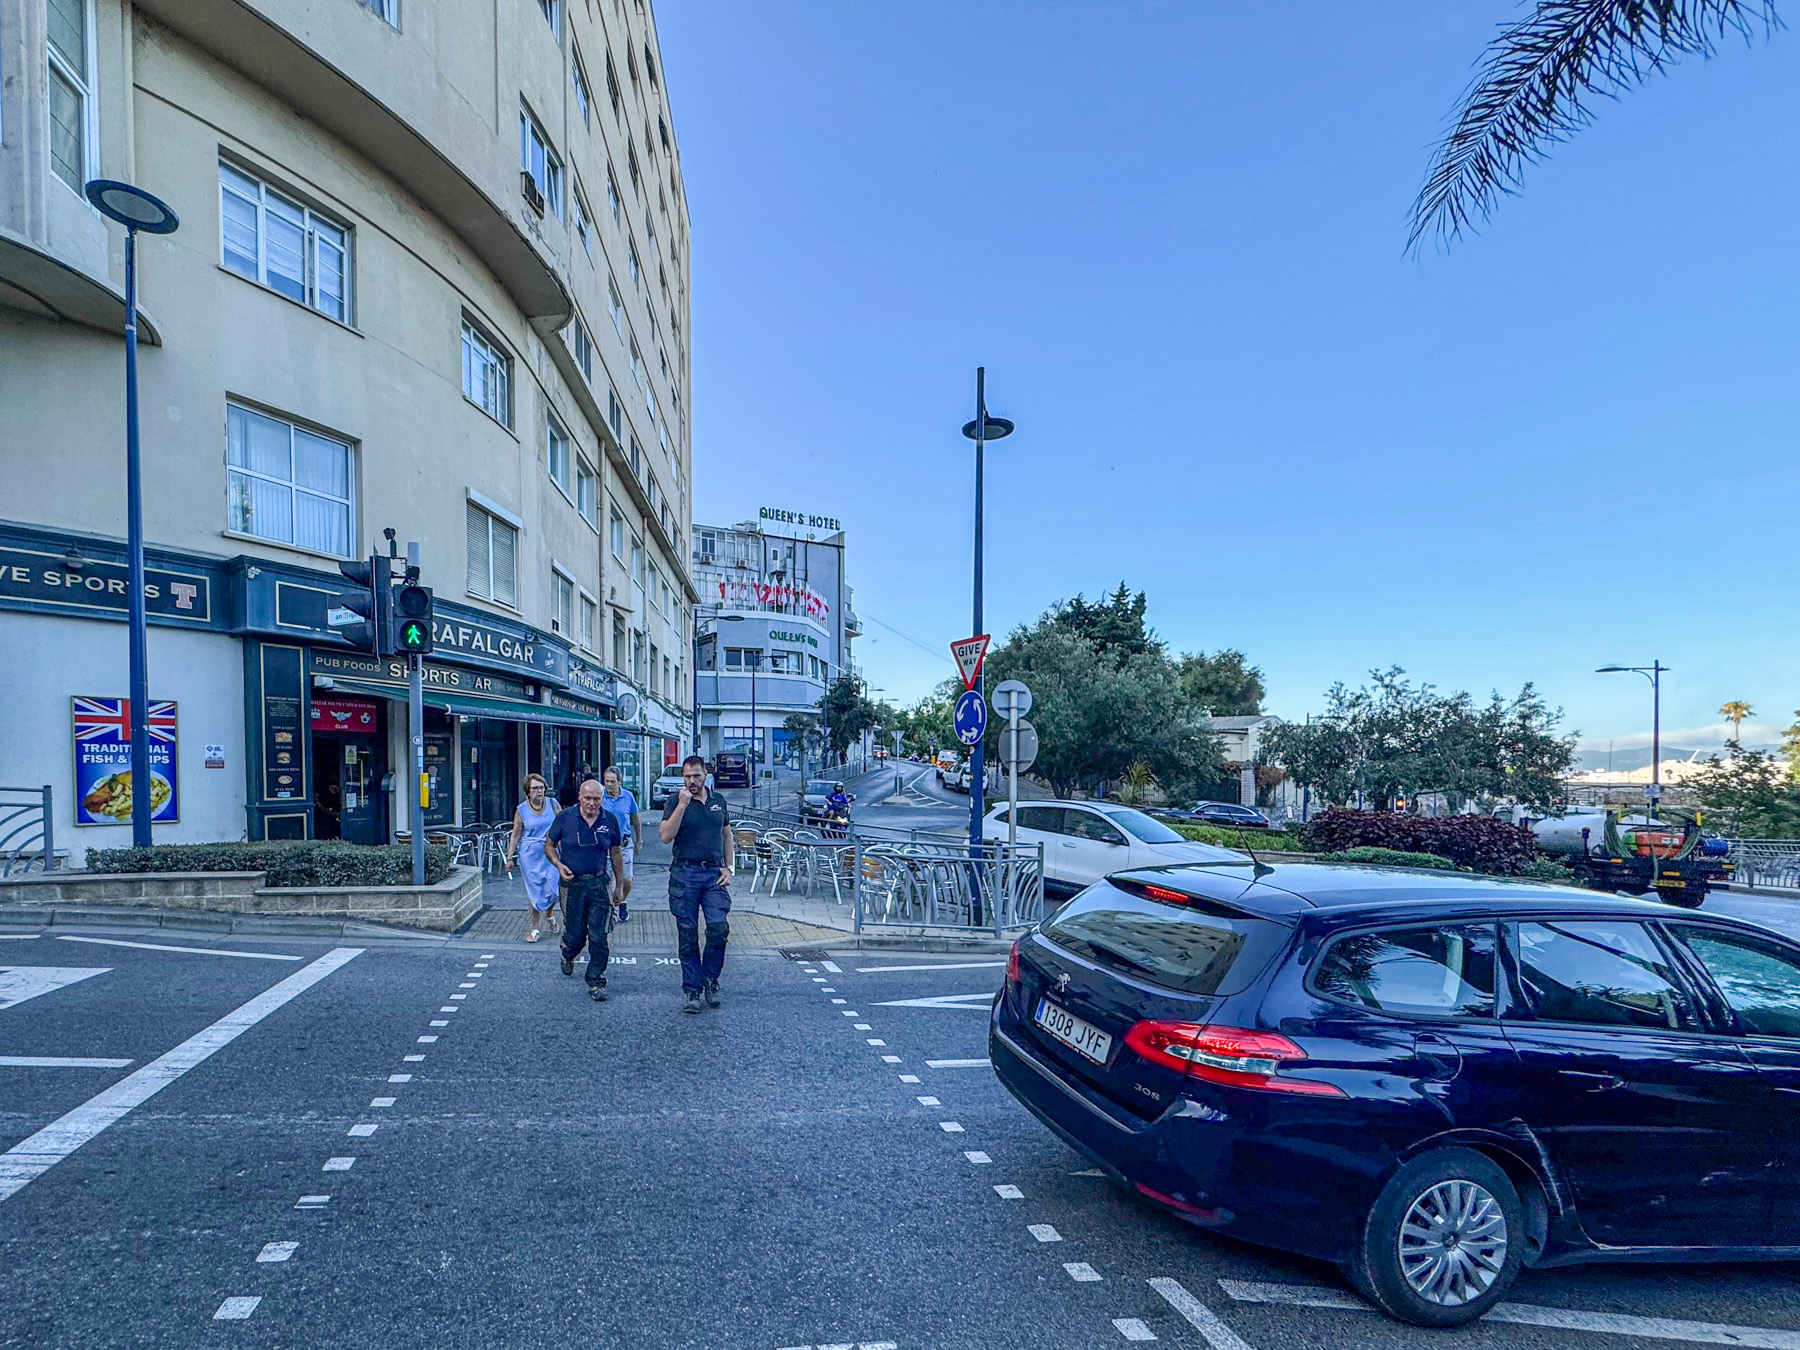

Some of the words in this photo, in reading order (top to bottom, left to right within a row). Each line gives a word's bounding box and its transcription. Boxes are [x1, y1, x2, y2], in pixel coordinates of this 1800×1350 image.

[760, 507, 804, 525] QUEEN'S
[809, 514, 840, 531] HOTEL
[43, 571, 160, 598] SPORS
[432, 621, 534, 664] RAFALGAR
[769, 630, 806, 643] QUEEN'S
[958, 643, 980, 657] GIVE
[315, 656, 341, 667] PUB
[343, 660, 381, 672] FOODS
[963, 658, 977, 666] WAY
[83, 743, 169, 753] TRADITAL
[83, 754, 114, 764] FISH
[117, 754, 128, 764] &
[149, 755, 170, 764] IPS
[1044, 1005, 1073, 1037] 1308
[1075, 1026, 1106, 1053] JYF
[1133, 1082, 1160, 1101] 308
